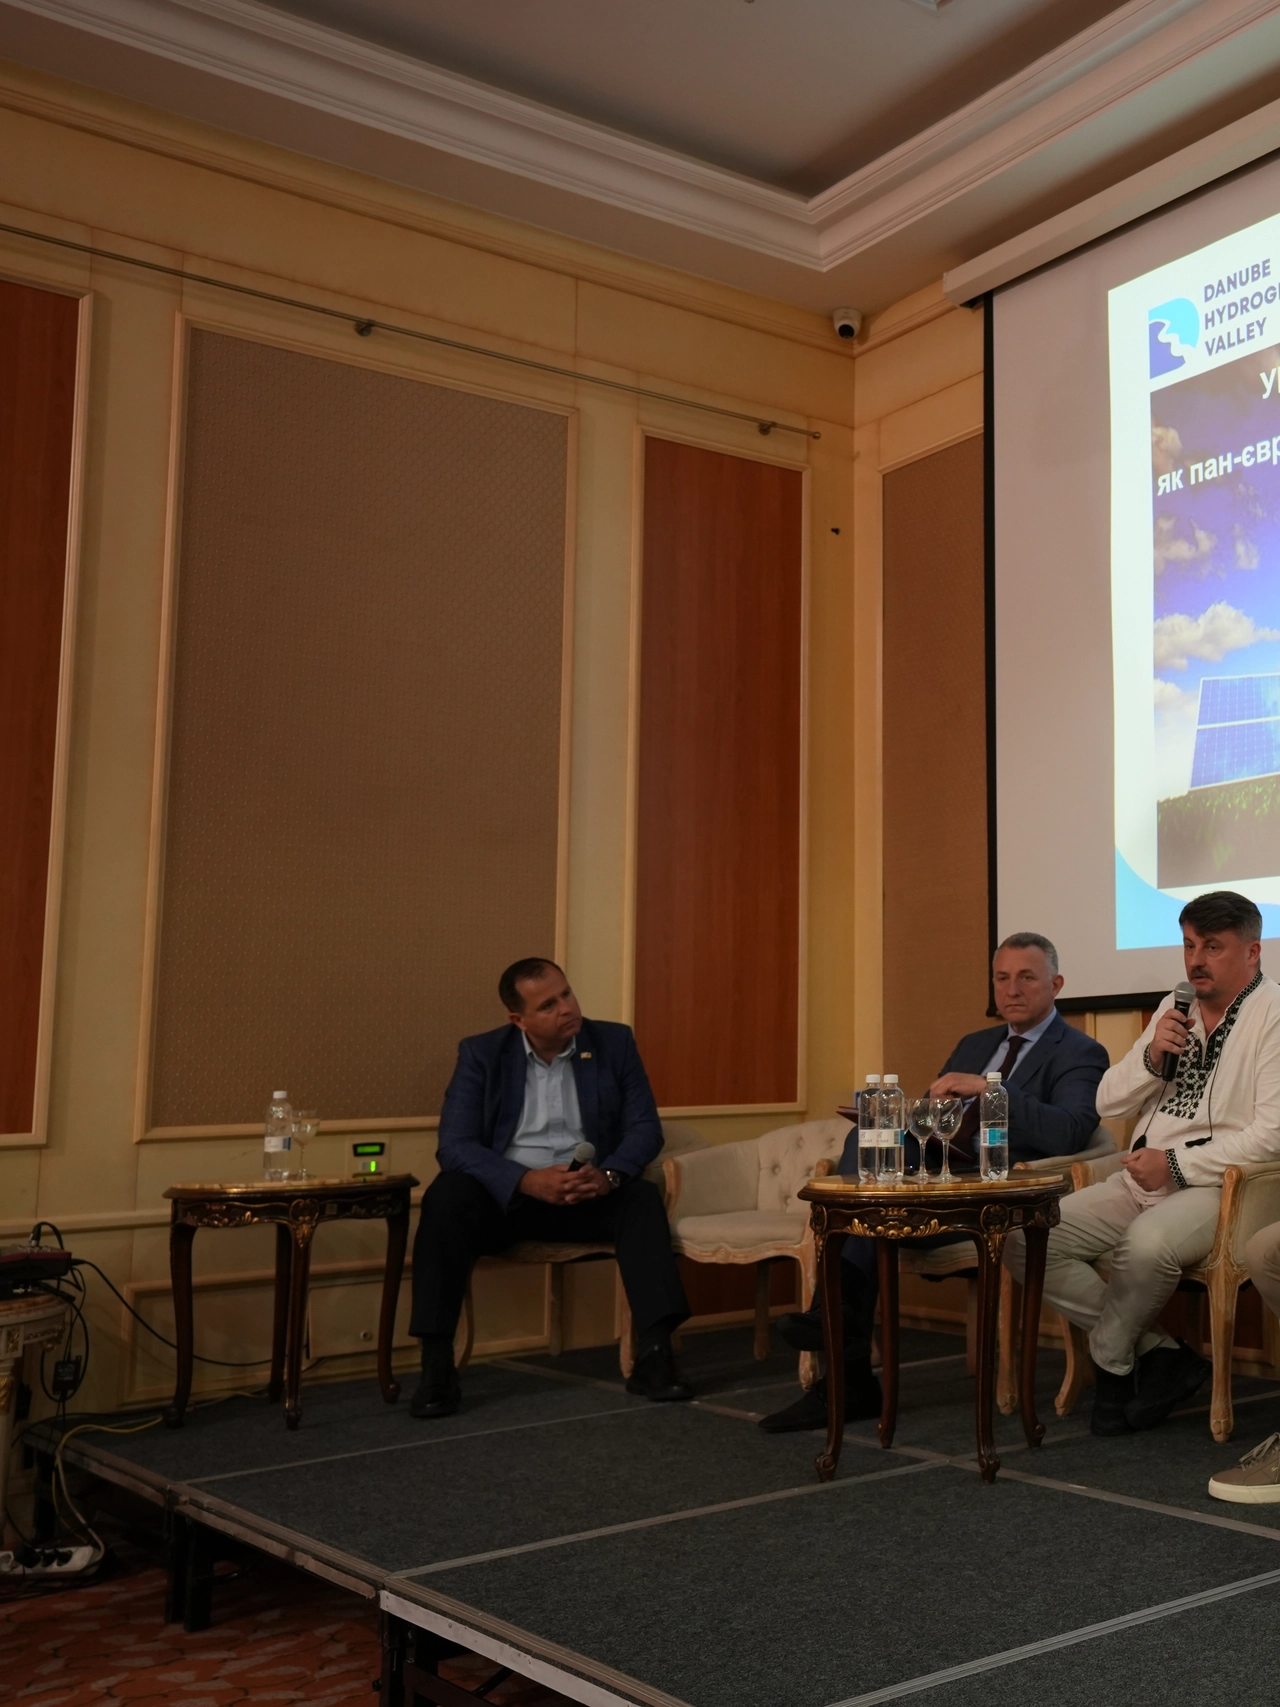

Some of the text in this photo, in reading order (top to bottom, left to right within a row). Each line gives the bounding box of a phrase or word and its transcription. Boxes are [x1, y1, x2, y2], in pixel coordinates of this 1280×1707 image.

[1204, 258, 1271, 303] DANUBE
[1204, 317, 1267, 357] VALLEY
[1157, 469, 1184, 496] як
